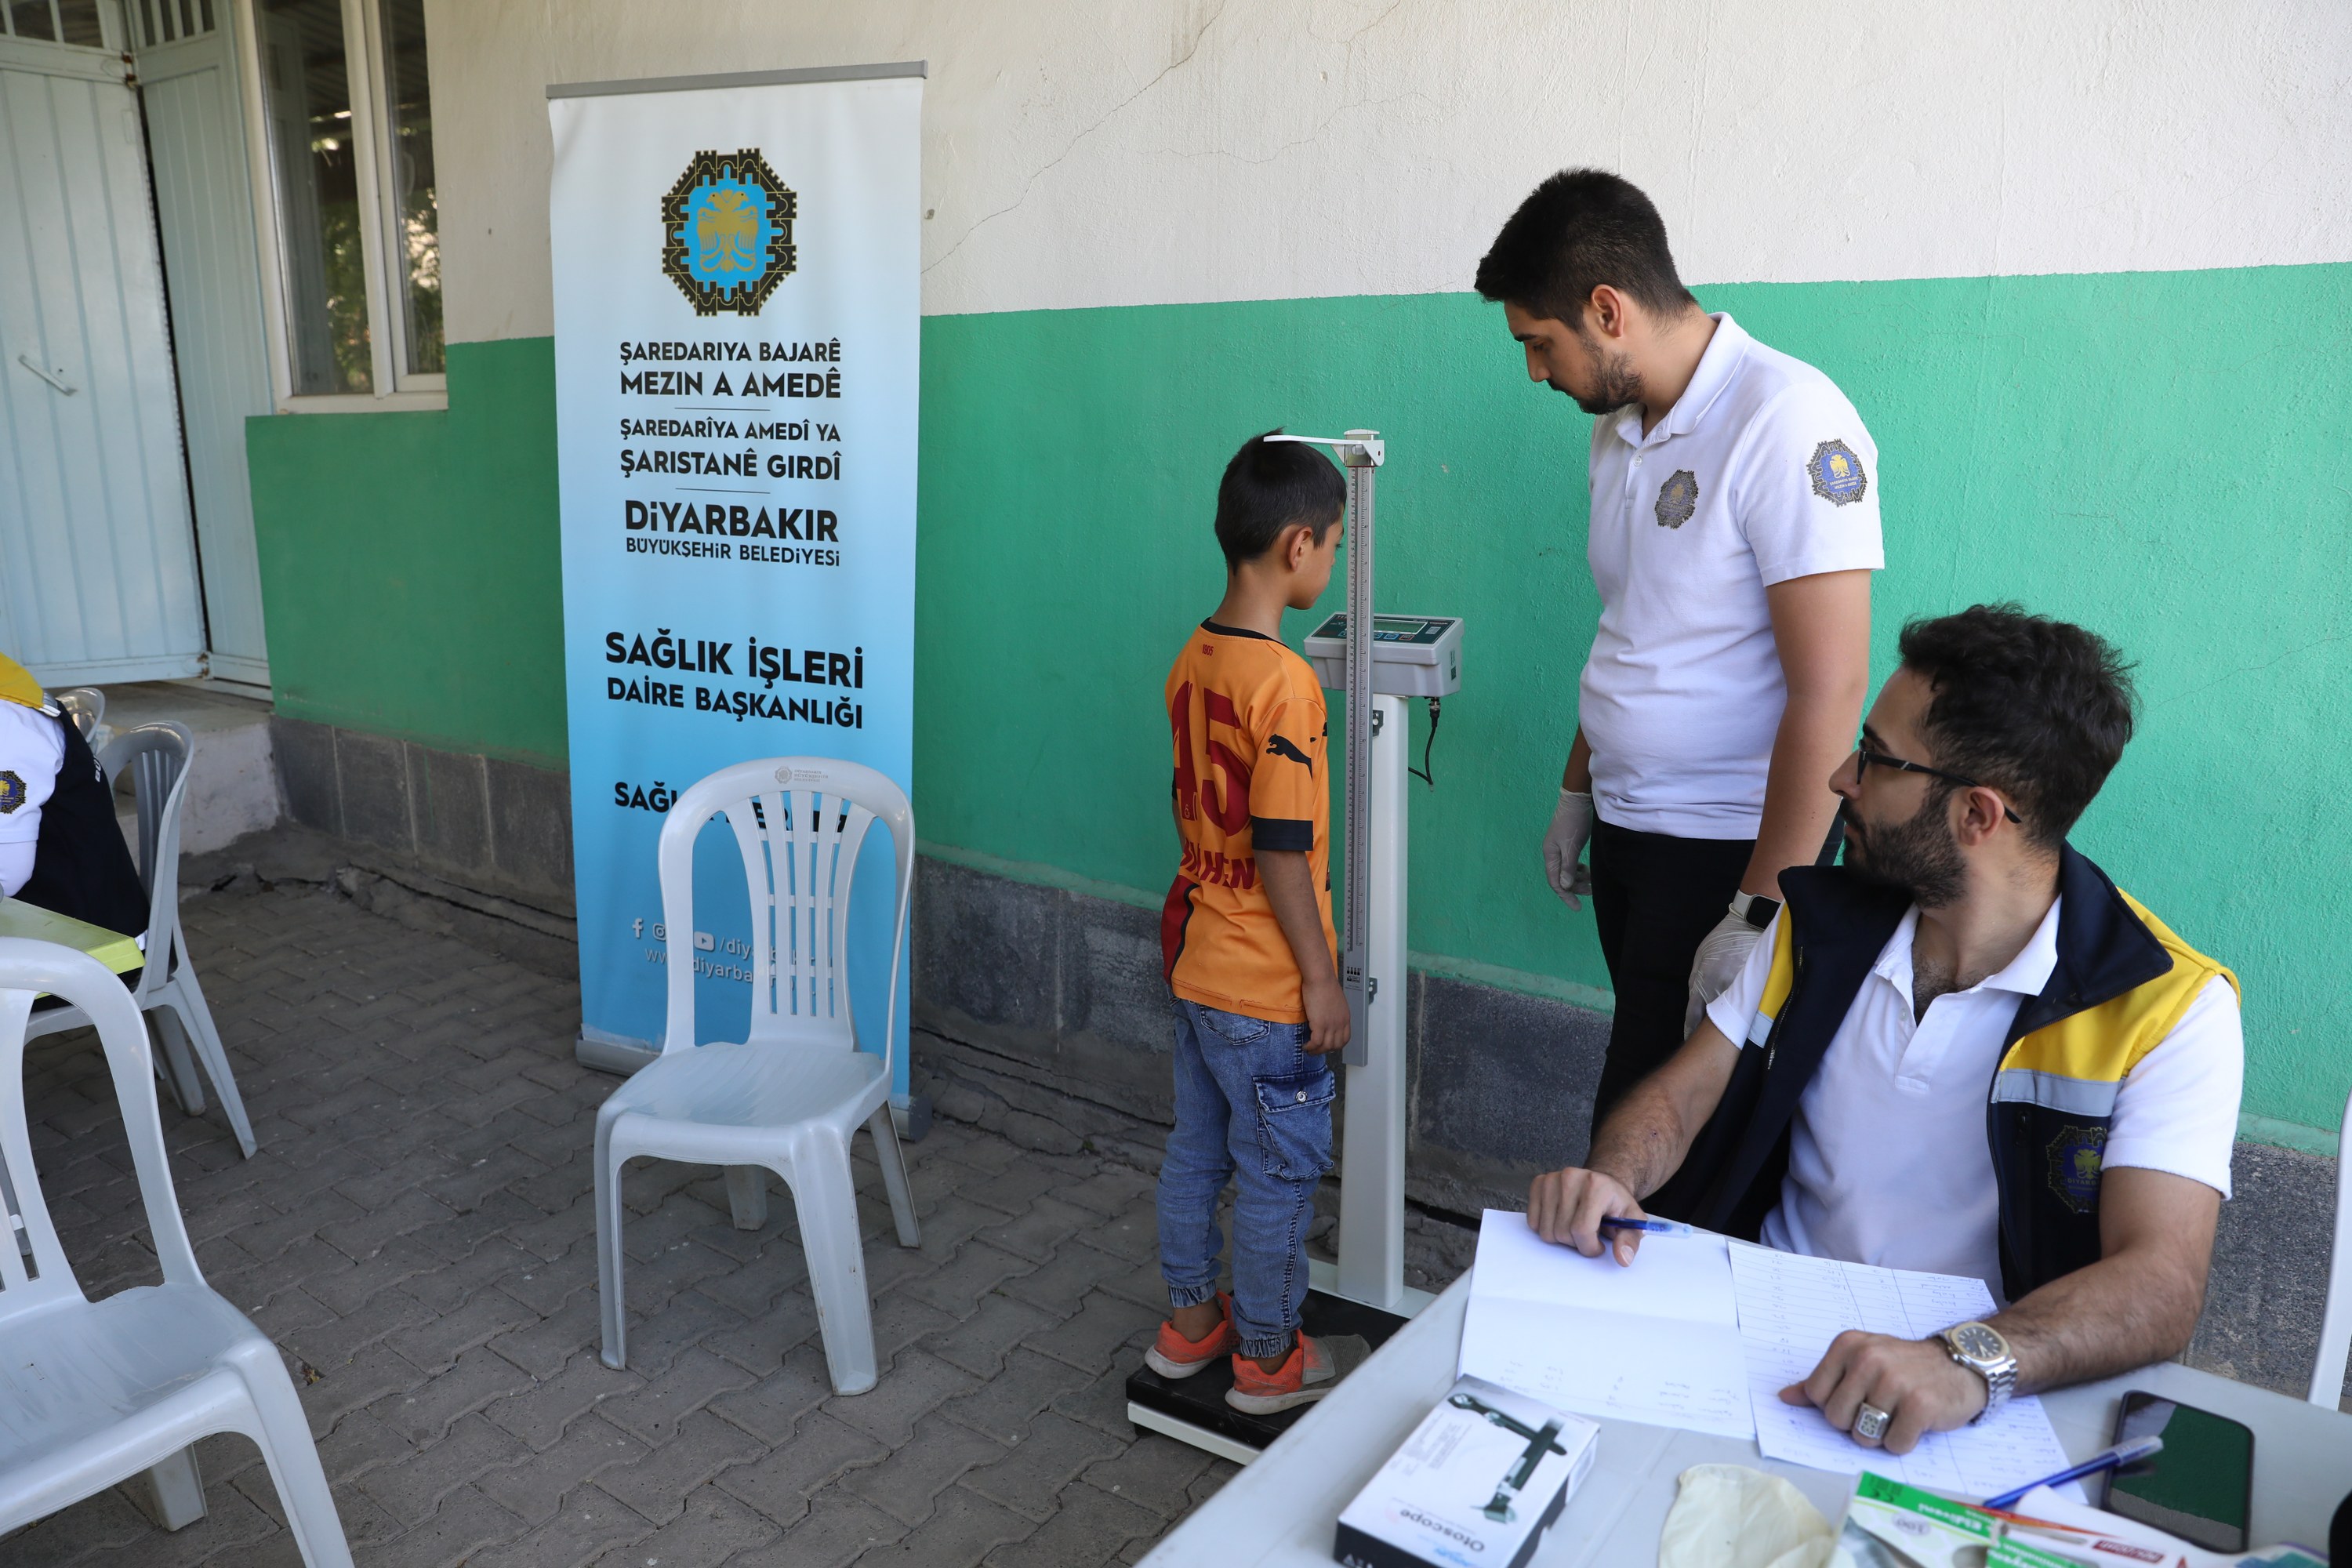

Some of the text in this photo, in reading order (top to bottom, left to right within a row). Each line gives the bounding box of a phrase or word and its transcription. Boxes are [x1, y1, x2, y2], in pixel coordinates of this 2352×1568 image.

[621, 337, 840, 365] ŞAREDARIYA BAJARÊ
[621, 366, 841, 398] MEZIN A AMEDÊ
[621, 416, 841, 442] ŞAREDARÎYA AMEDÎ YA
[621, 447, 843, 480] ŞARISTANÊ GIRDÎ
[606, 628, 863, 690] SAĞLIK İŞLERİ
[607, 675, 863, 729] DAİRE BAŞKANLIĞI
[1399, 1508, 1486, 1553] Otoscope
